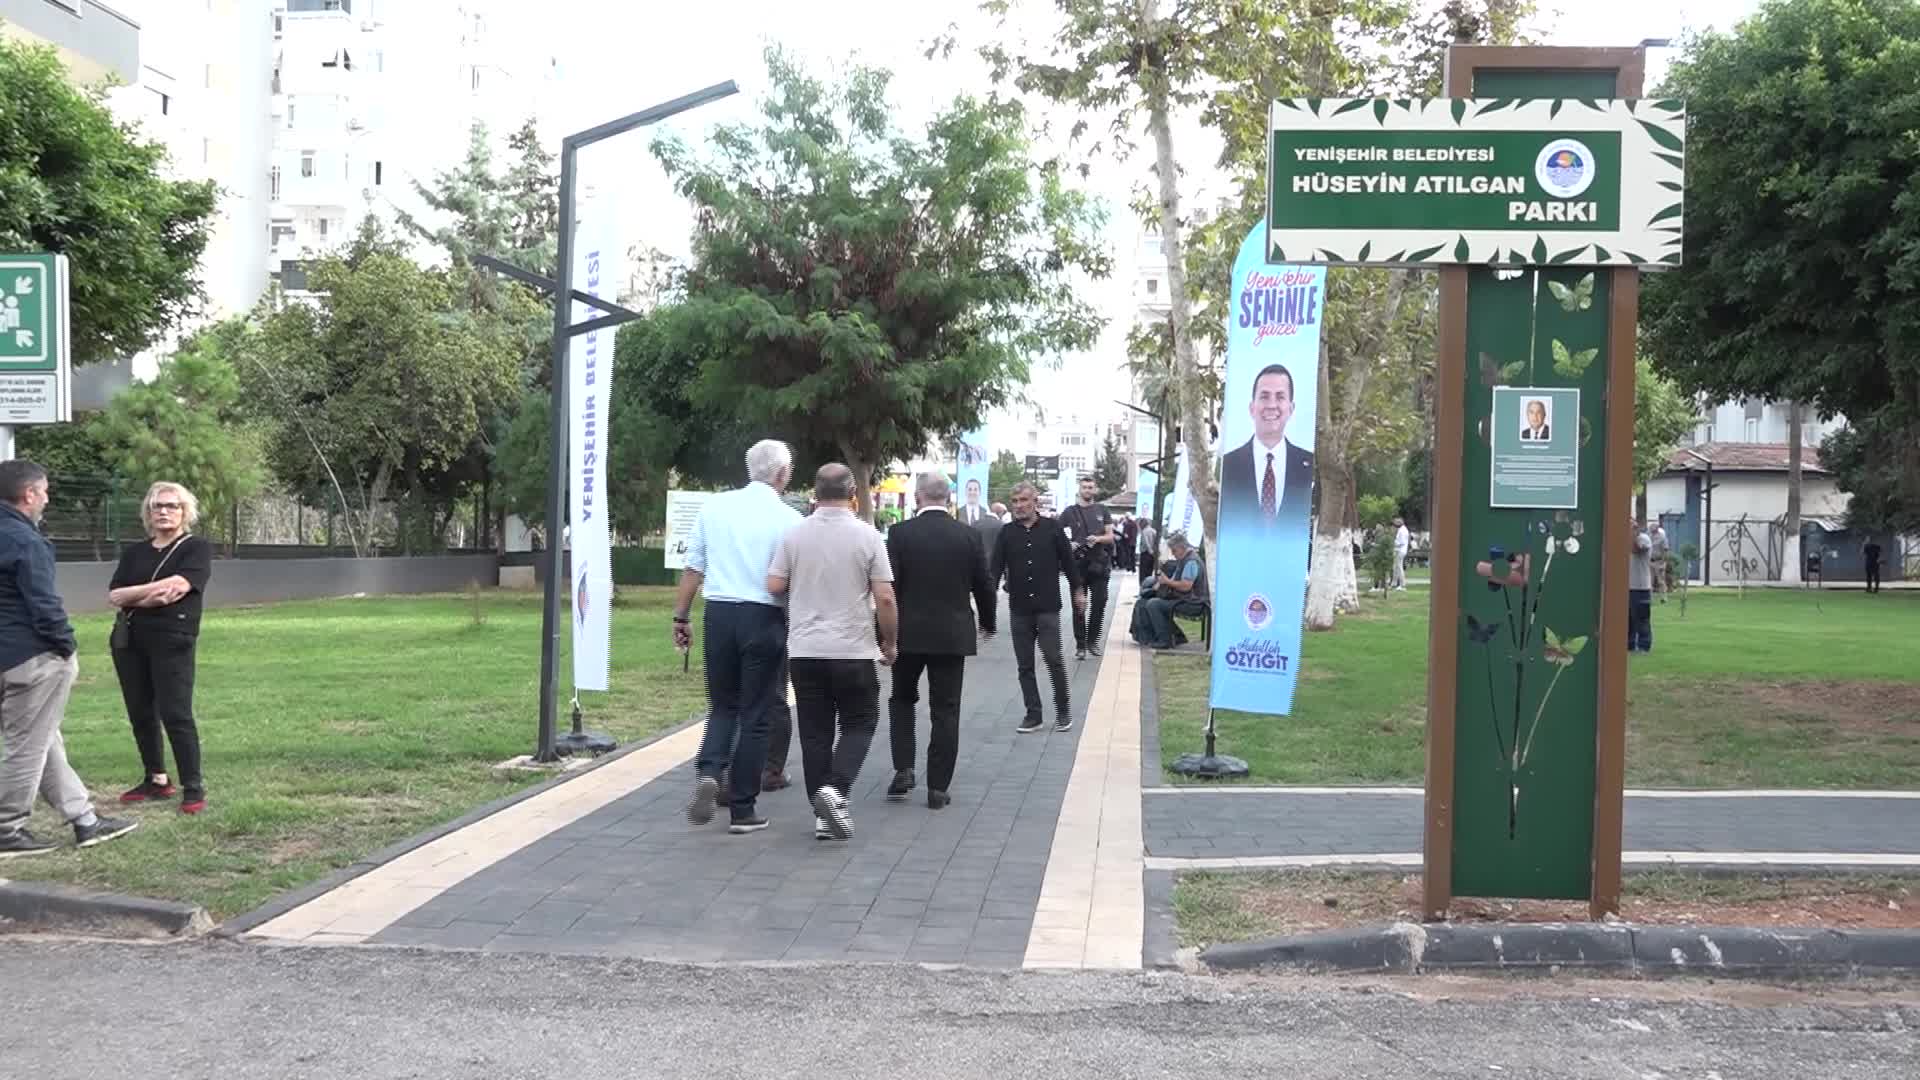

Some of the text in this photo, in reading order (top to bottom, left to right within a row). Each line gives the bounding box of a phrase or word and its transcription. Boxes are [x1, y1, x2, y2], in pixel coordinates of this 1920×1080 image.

[1295, 146, 1495, 163] YENİŞEHİR BELEDİYESİ
[1293, 172, 1525, 193] HÜSEYİN ATILGAN
[1508, 201, 1597, 222] PARKI
[582, 395, 597, 522] YENİŞEHİR
